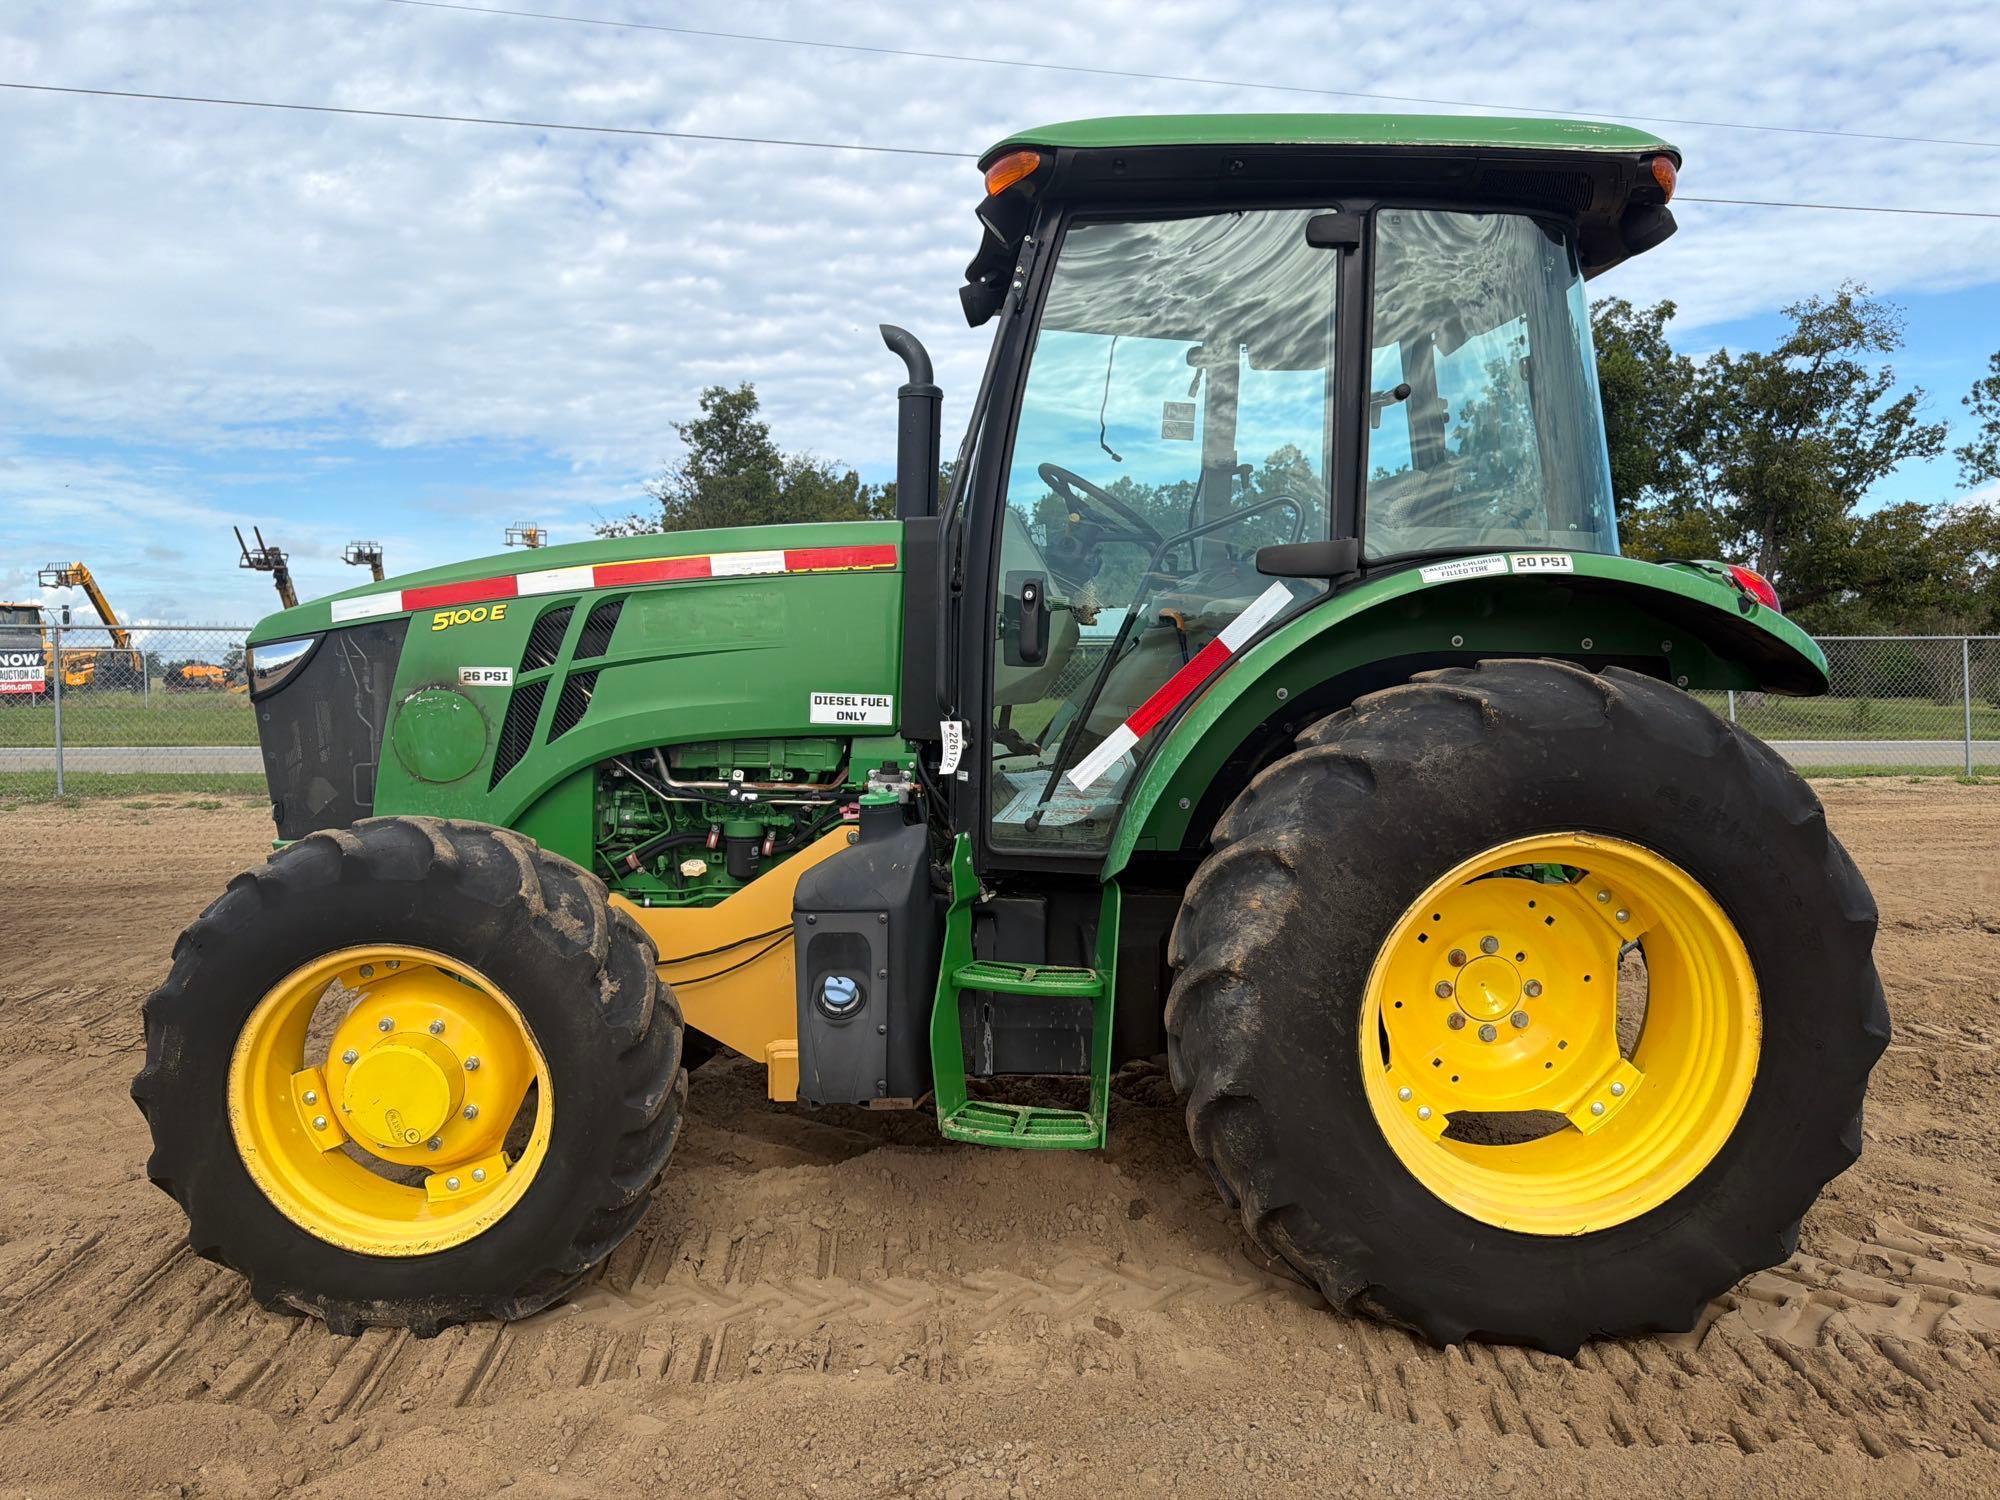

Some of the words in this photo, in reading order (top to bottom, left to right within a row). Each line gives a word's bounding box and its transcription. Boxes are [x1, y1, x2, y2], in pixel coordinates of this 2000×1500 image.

[1423, 563, 1461, 573] CALCIUM
[1462, 557, 1501, 567] CHLORIDE
[1516, 557, 1538, 568] 20
[1541, 557, 1568, 568] PSI
[1441, 567, 1469, 577] FILLED
[1470, 564, 1489, 574] TIRE
[463, 671, 481, 681] 26
[484, 671, 509, 681] PSI
[814, 695, 858, 707] DIESEL
[860, 697, 890, 708] FUEL
[836, 711, 867, 722] ONLY
[947, 732, 959, 768] 226172
